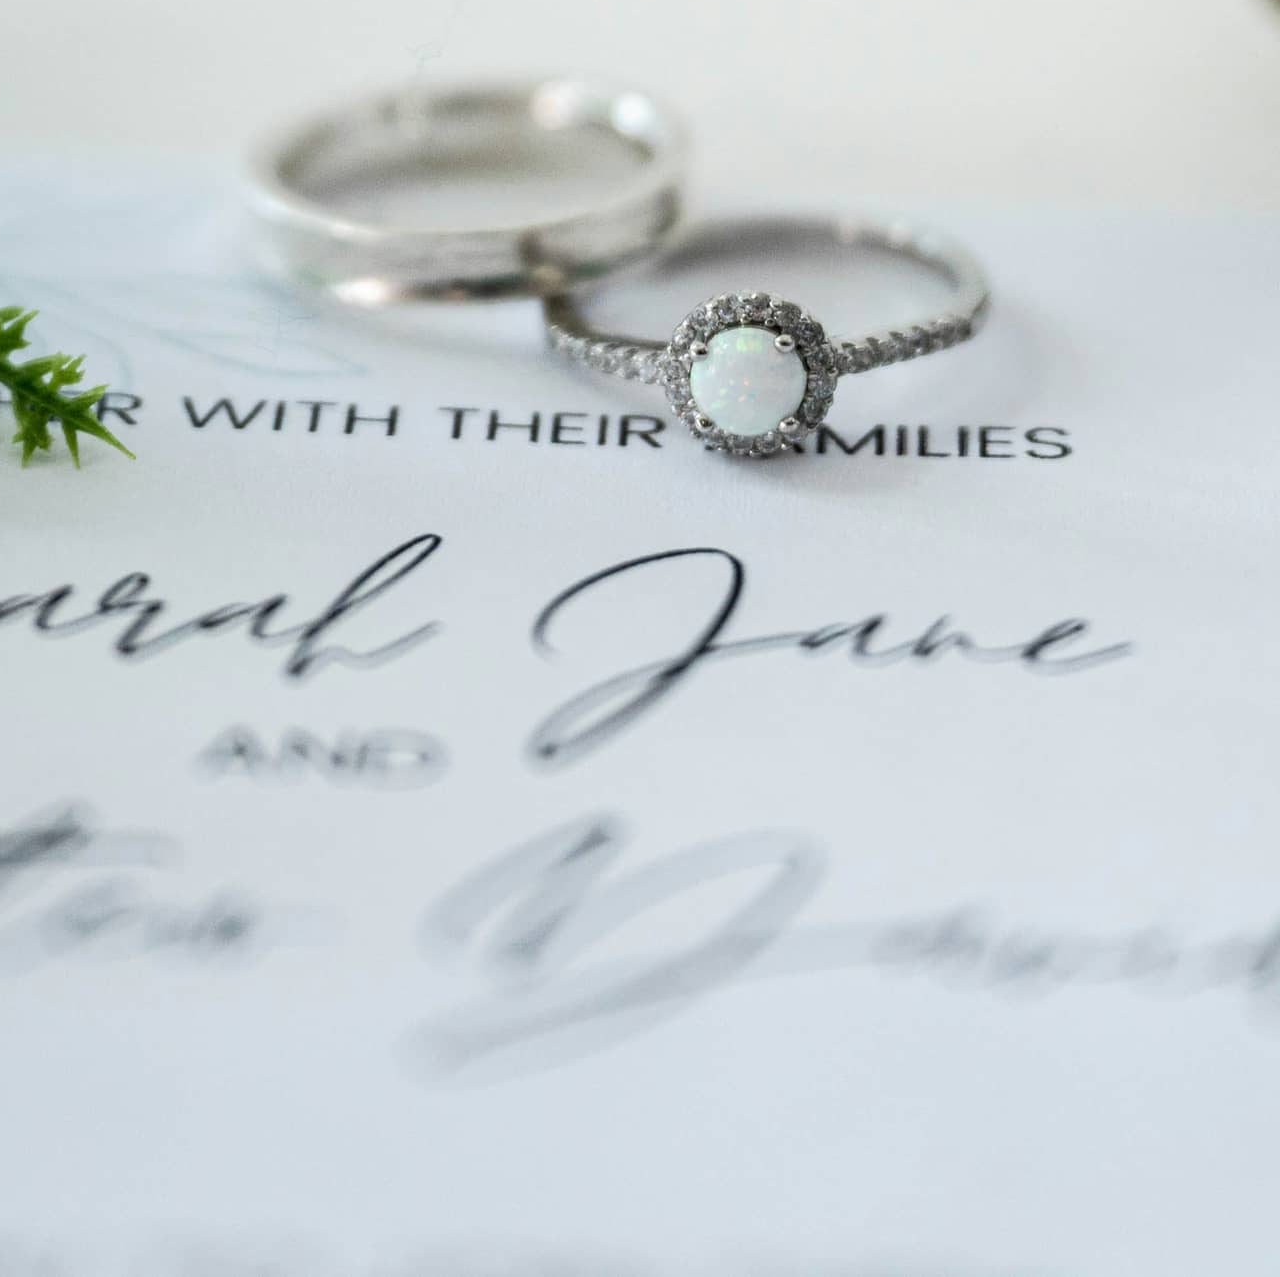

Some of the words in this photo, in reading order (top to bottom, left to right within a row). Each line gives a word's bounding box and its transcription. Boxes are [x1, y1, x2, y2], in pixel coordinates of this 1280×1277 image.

[182, 395, 401, 437] WITH
[440, 406, 664, 450] THEIR
[705, 420, 1074, 460] MILIES
[525, 546, 1132, 774] Jane
[190, 722, 452, 788] AND
